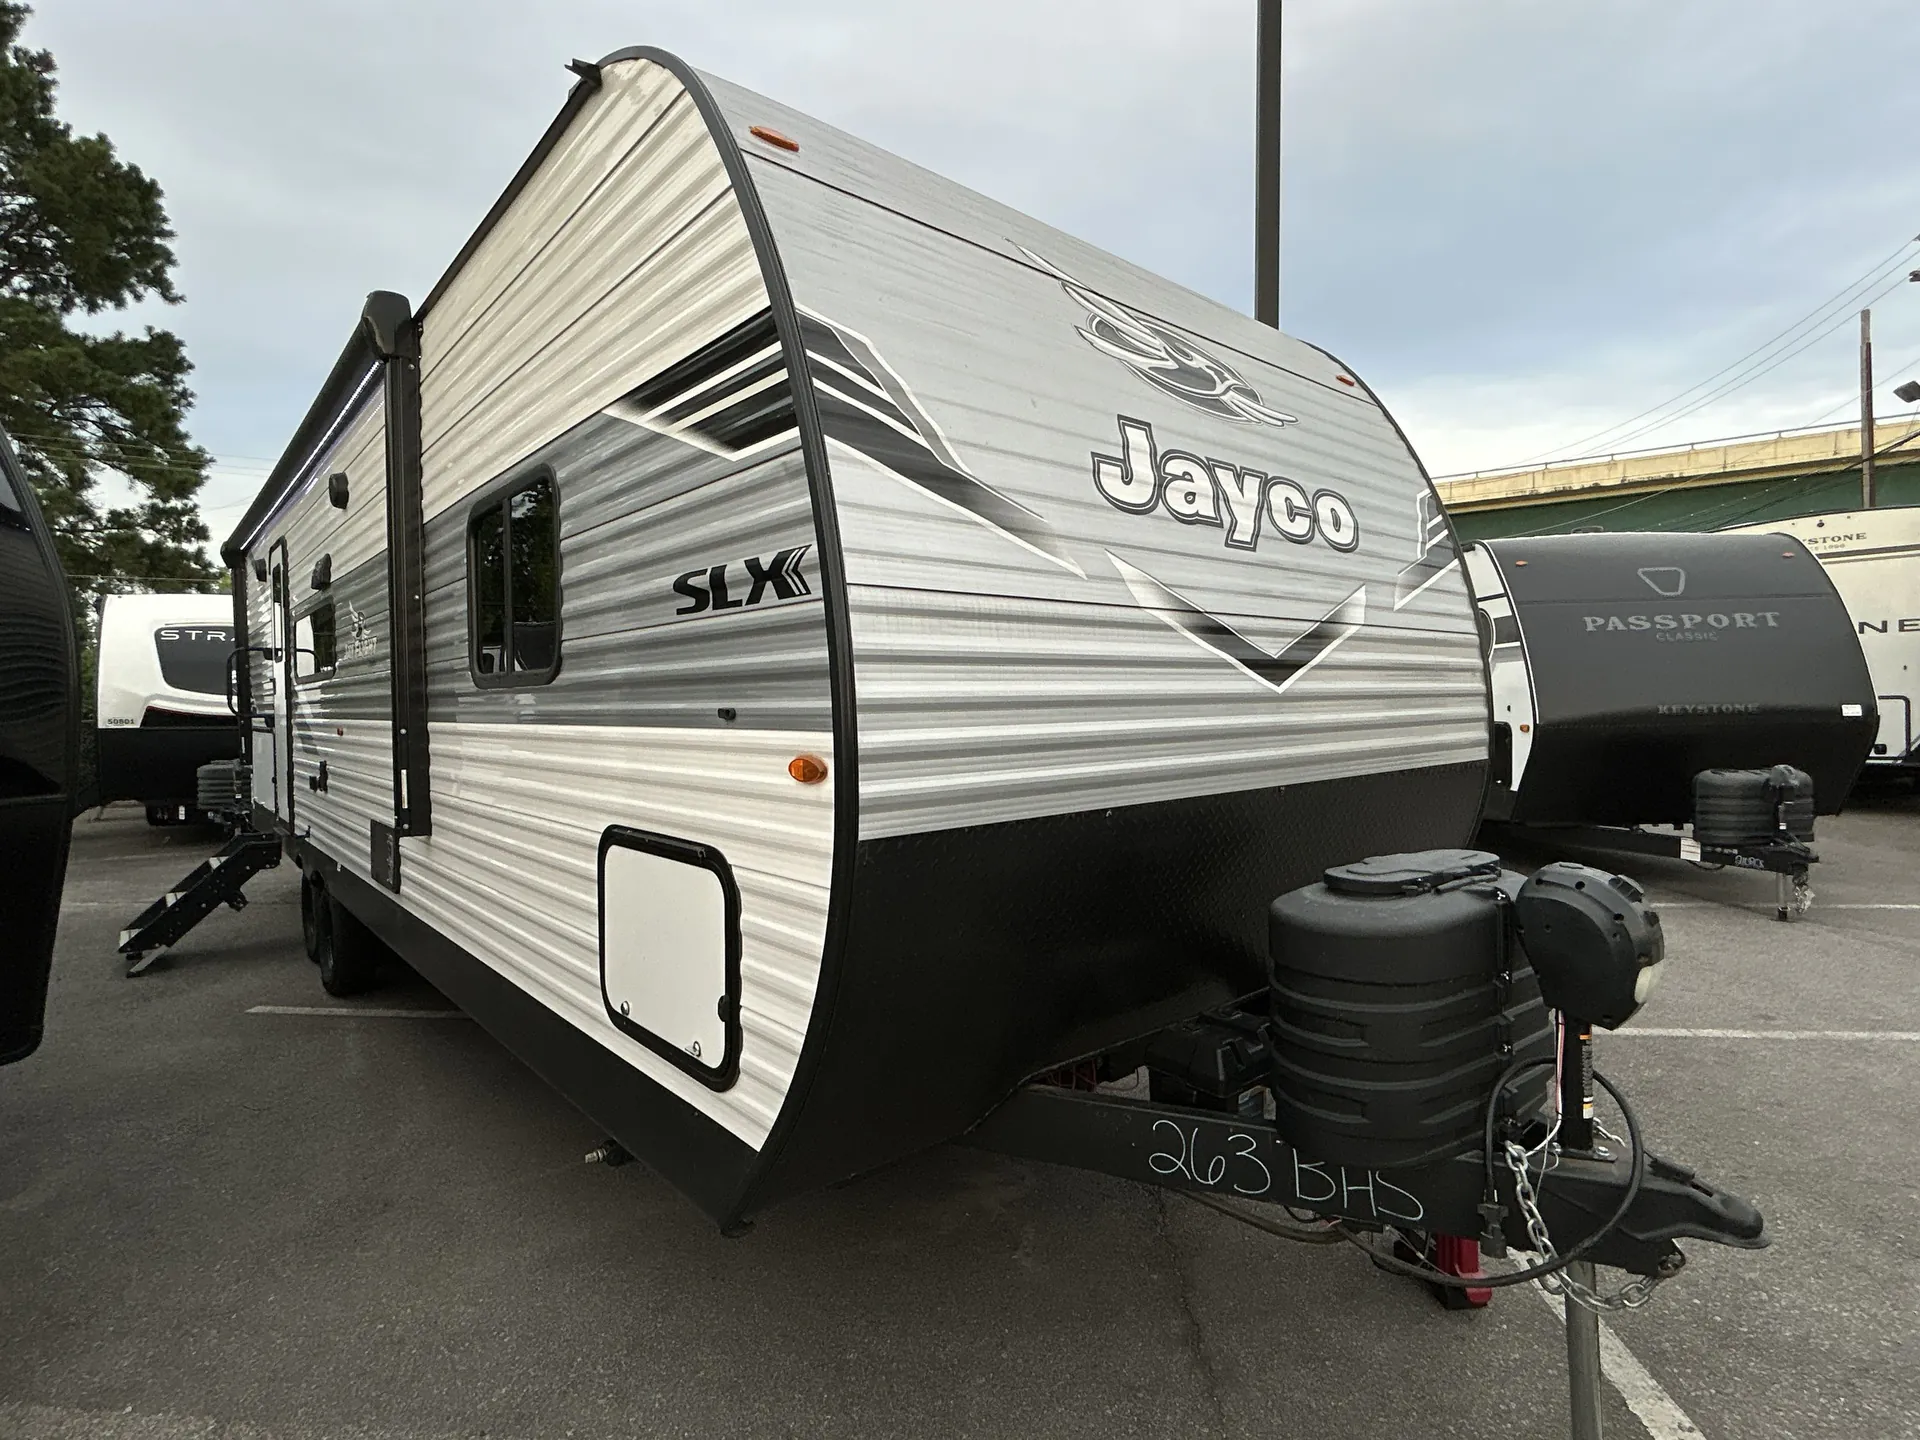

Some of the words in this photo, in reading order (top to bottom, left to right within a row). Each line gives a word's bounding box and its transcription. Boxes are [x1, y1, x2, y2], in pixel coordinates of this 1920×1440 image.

[1090, 413, 1360, 553] Jayco
[1802, 532, 1867, 545] STONE
[672, 544, 812, 616] SLX
[1582, 611, 1780, 632] PASSPORT
[160, 629, 236, 641] STR
[1655, 631, 1720, 643] CLASSIC
[1656, 702, 1761, 715] KEYSTONE
[1148, 1119, 1272, 1195] 263
[1292, 1147, 1425, 1222] BHS
